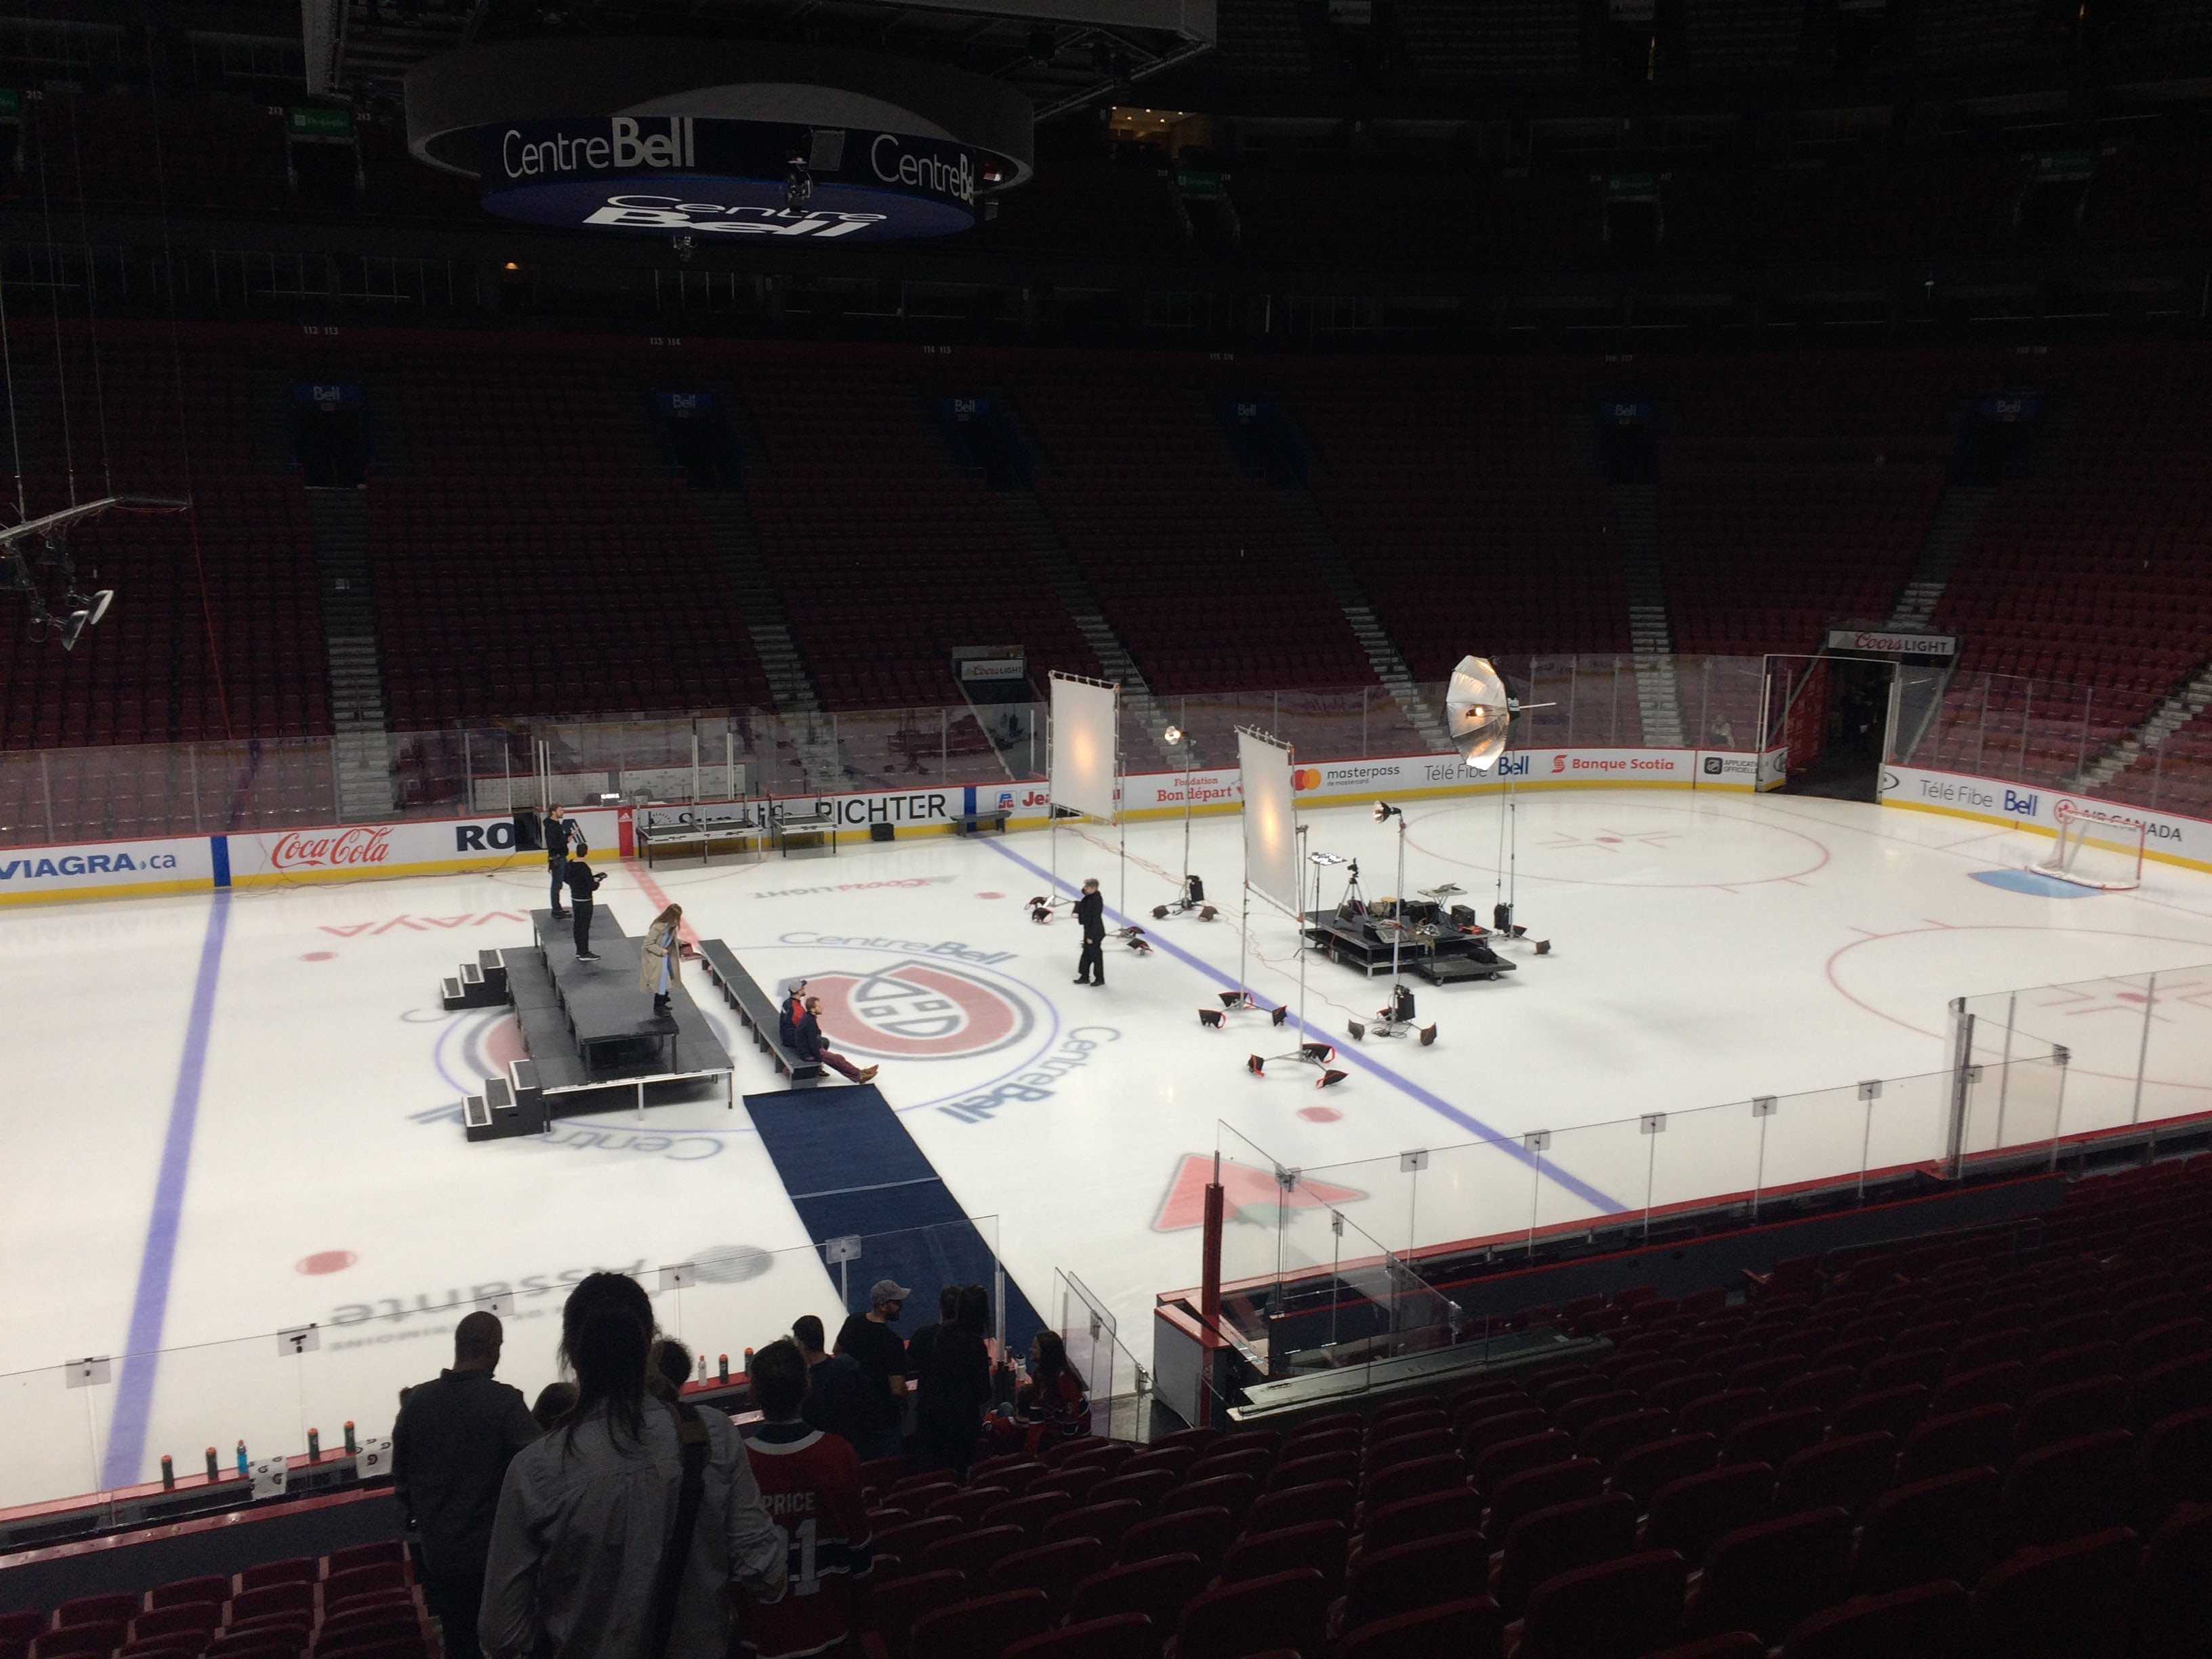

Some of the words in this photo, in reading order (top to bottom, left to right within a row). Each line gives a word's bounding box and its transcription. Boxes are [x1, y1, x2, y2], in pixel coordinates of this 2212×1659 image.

[356, 112, 371, 122] 213
[607, 194, 888, 222] Centre
[582, 207, 872, 237] Bell
[312, 386, 341, 401] Bell
[672, 394, 697, 409] Bell
[954, 398, 976, 413] Bell
[1996, 399, 2022, 413] Bell
[1237, 403, 1257, 417] Bell
[1615, 403, 1637, 417] Bell
[1855, 632, 1903, 651] Coors
[1904, 640, 1948, 653] LIGHT
[1000, 666, 1023, 674] LIGHT
[1425, 764, 1454, 781] Télé
[1498, 756, 1530, 776] Bell
[1572, 758, 1626, 771] Banque
[1631, 758, 1674, 770] Scotia
[1327, 766, 1400, 780] masterpass
[1174, 778, 1218, 786] Fondation
[1157, 790, 1184, 802] Bon
[1187, 786, 1232, 802] départ
[1920, 779, 1955, 801] Télé
[1958, 785, 1993, 808] Fibe
[2004, 789, 2039, 817] Bell
[815, 794, 946, 825] RICHTER
[272, 827, 394, 869] Coca-Cola
[754, 886, 834, 899] LIGHT
[318, 909, 531, 938] VAYA
[761, 1492, 816, 1514] PRICE
